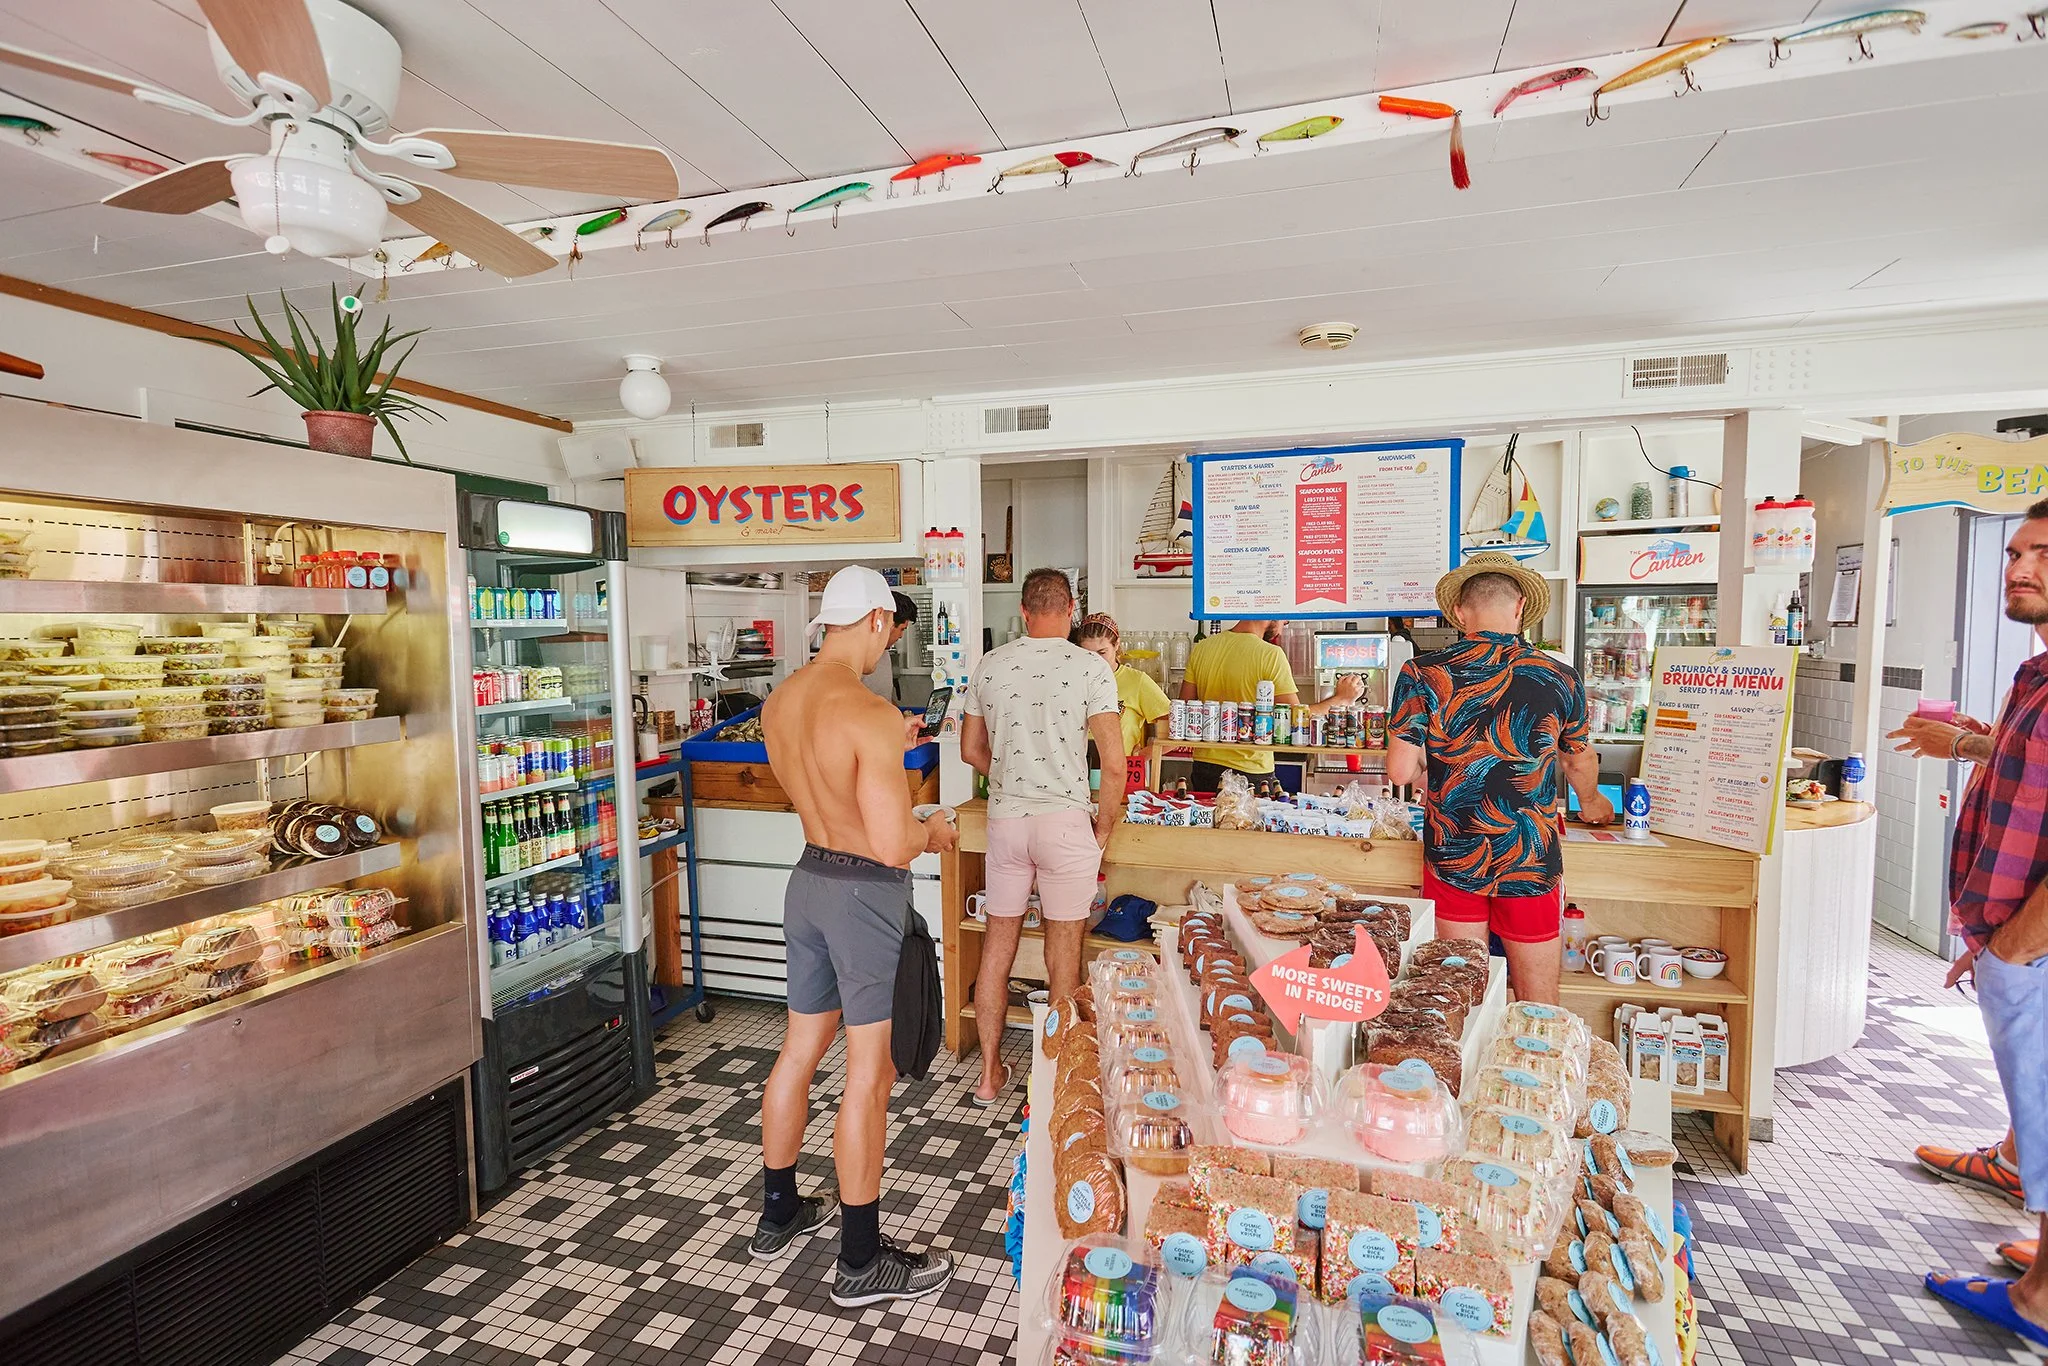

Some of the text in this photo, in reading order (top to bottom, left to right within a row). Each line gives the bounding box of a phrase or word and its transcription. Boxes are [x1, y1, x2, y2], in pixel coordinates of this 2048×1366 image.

[1896, 457, 1924, 474] TO
[1934, 454, 1974, 475] THE
[662, 482, 865, 526] OYSTERS
[755, 526, 784, 536] more!
[1630, 547, 1706, 580] Canteen
[1670, 664, 1776, 676] SATURDAY & SUNDAY
[1662, 672, 1784, 690] BRUNCH MENU
[1680, 686, 1707, 694] SERVED
[1720, 688, 1732, 696] AM
[1731, 706, 1755, 714] SAVORY
[1664, 746, 1688, 755] DRINKS
[1127, 770, 1141, 783] 79
[1166, 813, 1184, 821] CAPE
[1192, 810, 1211, 818] CAPE
[1708, 809, 1734, 818] CAULIFLOWER
[1626, 818, 1650, 829] RAIN
[1732, 829, 1748, 837] SPROUTS
[1272, 964, 1382, 1002] MORE SWEETS
[1285, 983, 1364, 1014] IN FRIDGE
[1240, 1222, 1262, 1230] COSMIC
[1173, 1247, 1195, 1255] COSMIC
[1174, 1256, 1195, 1264] KRISPIE
[1456, 1302, 1480, 1311] COSMIC
[1456, 1312, 1479, 1320] KRISPIE
